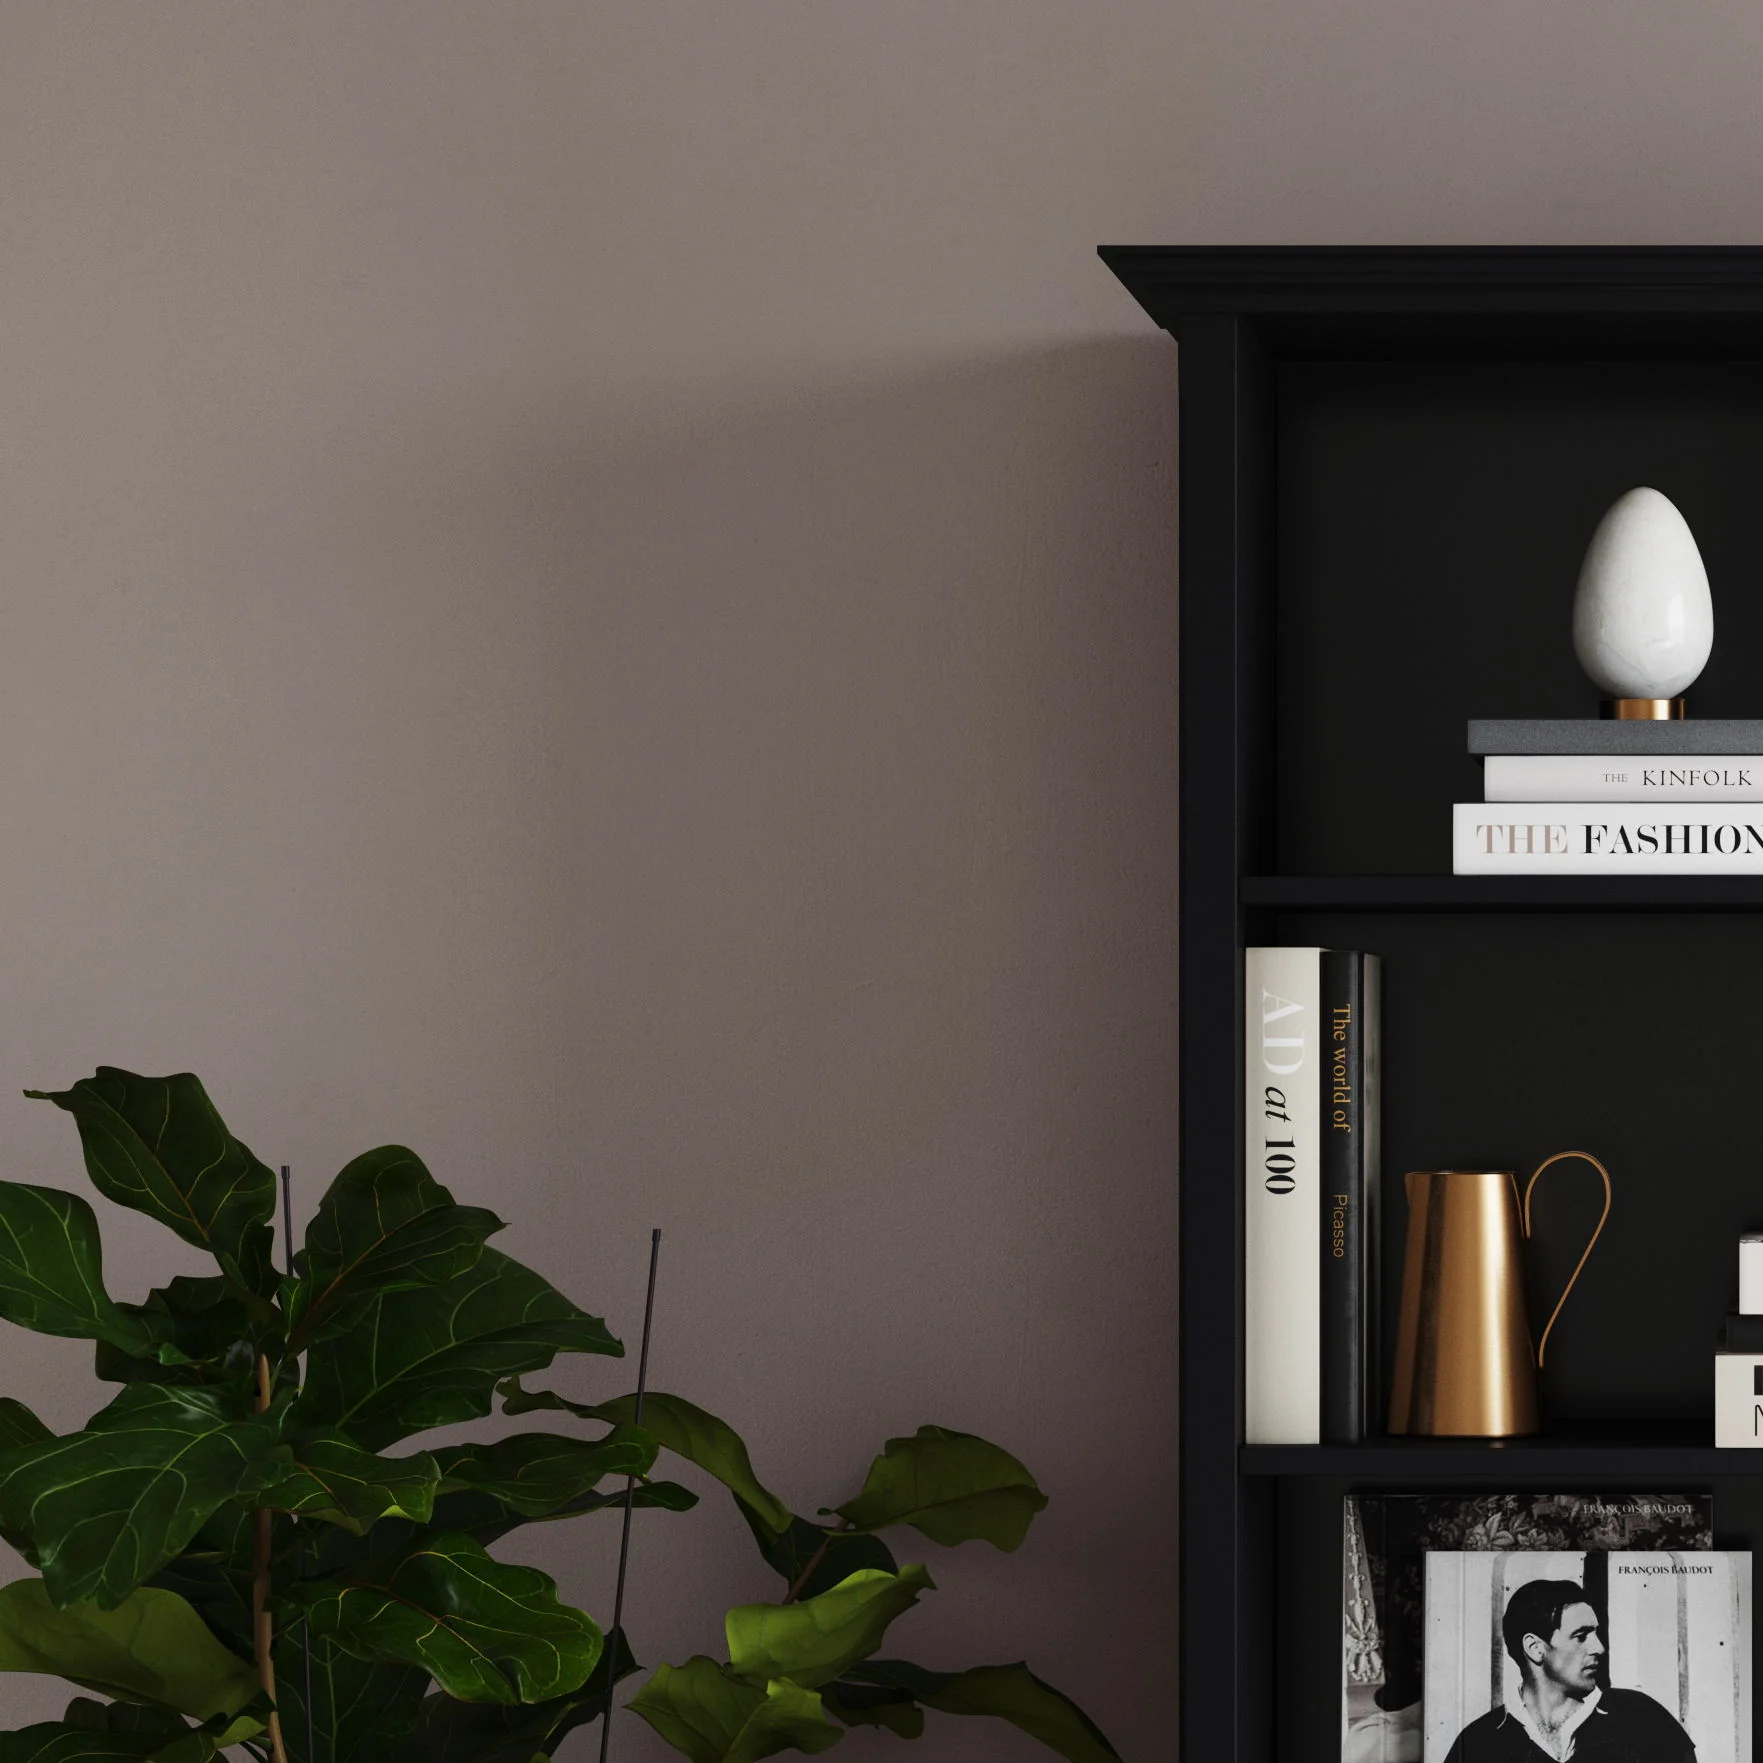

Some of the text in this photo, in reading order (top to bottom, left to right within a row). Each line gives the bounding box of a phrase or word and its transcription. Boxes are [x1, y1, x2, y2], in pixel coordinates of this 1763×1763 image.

[1602, 773, 1628, 783] THE
[1643, 769, 1752, 786] KINFOLK
[1476, 824, 1568, 854] THE
[1333, 1003, 1351, 1132] The world of
[1262, 986, 1305, 1195] AD at 100
[1333, 1194, 1348, 1259] Picasso
[1644, 1504, 1693, 1514] BAUDOT
[1618, 1565, 1714, 1576] FRANÇOIS BAUDOT
